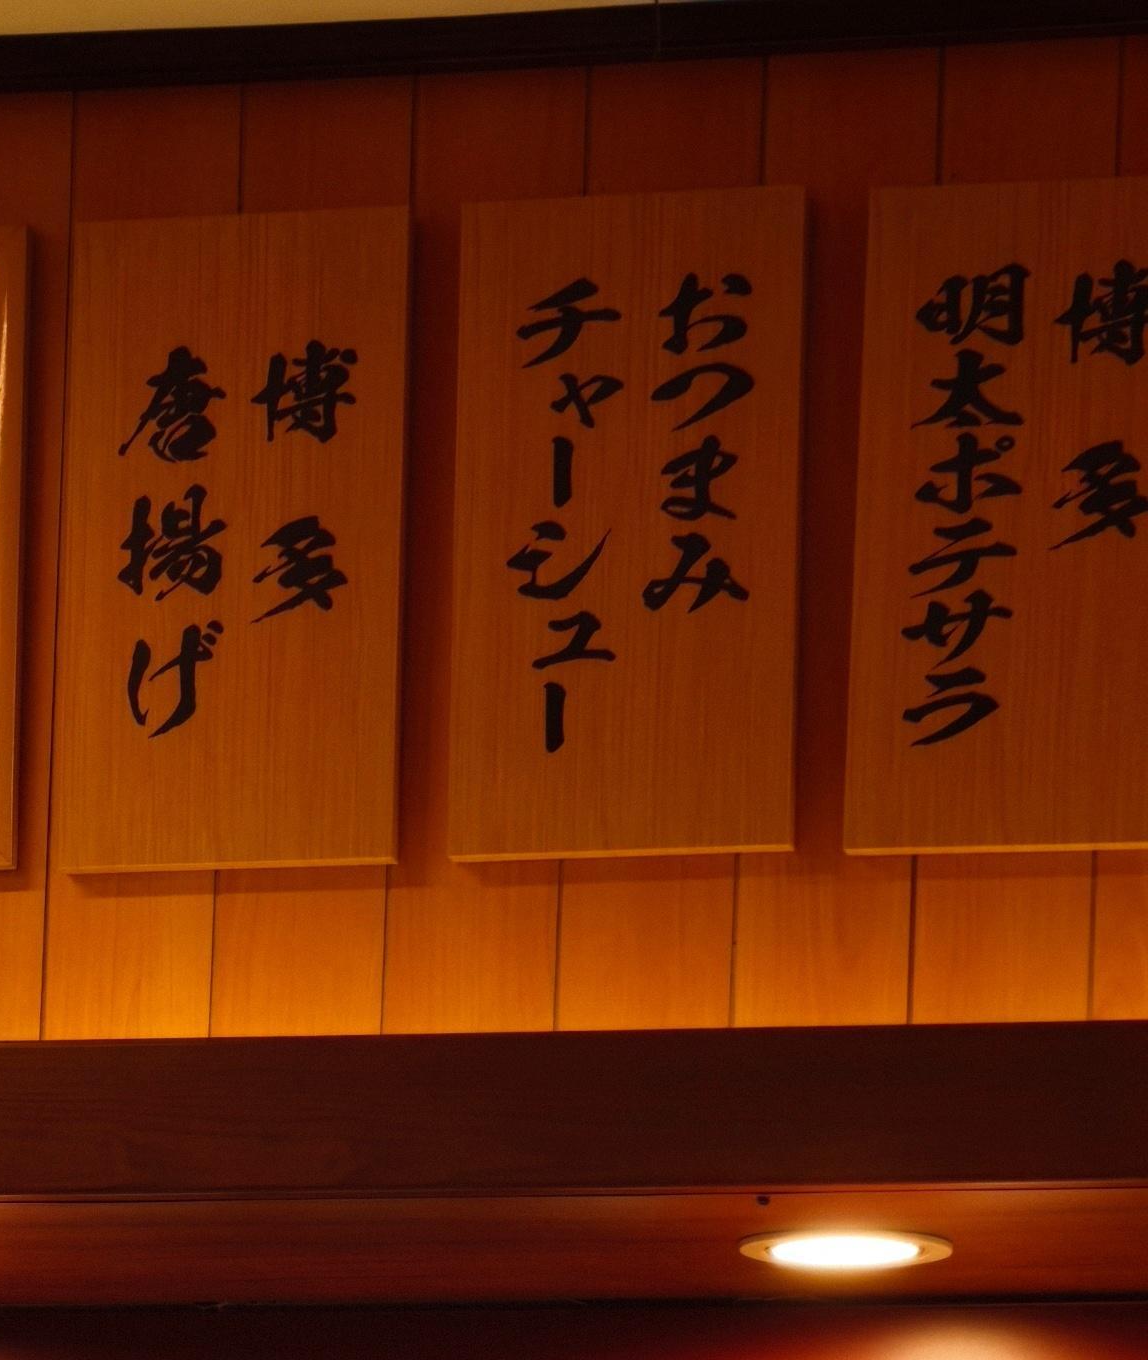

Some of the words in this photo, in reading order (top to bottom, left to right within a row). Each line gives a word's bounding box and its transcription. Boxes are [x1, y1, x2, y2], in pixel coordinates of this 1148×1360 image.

[118, 347, 228, 739] 唐揚げ
[251, 340, 358, 624] 博多
[505, 277, 624, 754] チャーシュー
[642, 272, 755, 614] おつまみ
[901, 261, 1030, 748] 明太ポテサラ
[1048, 259, 1148, 551] 博多
